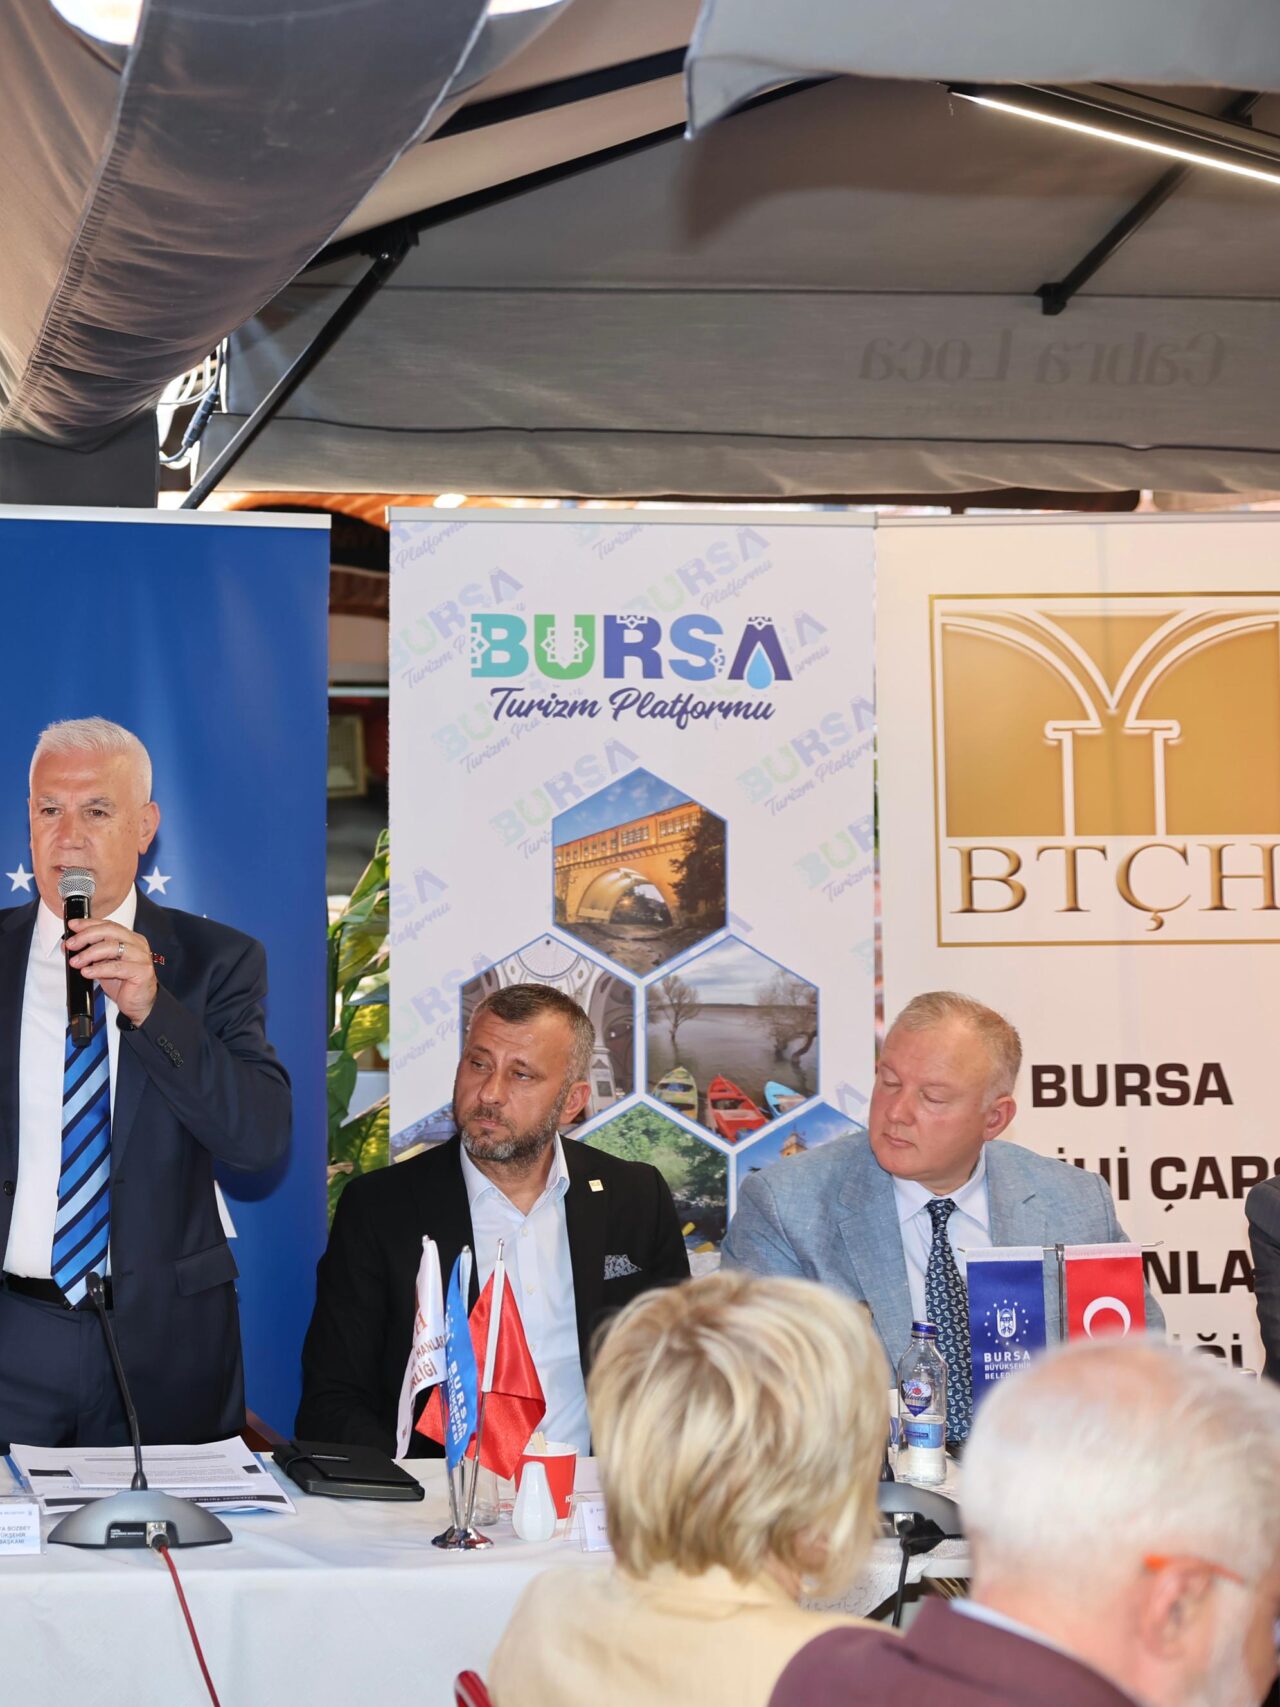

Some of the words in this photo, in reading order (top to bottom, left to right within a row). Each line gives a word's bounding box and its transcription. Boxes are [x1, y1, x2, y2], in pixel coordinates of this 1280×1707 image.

[470, 614, 793, 690] BURSA
[490, 687, 603, 721] Turizm
[608, 687, 775, 730] Platformu
[948, 844, 1280, 931] BTÇH
[1031, 1062, 1234, 1108] BURSA
[983, 1350, 1031, 1363] BURSA
[450, 1360, 468, 1437] BURSA
